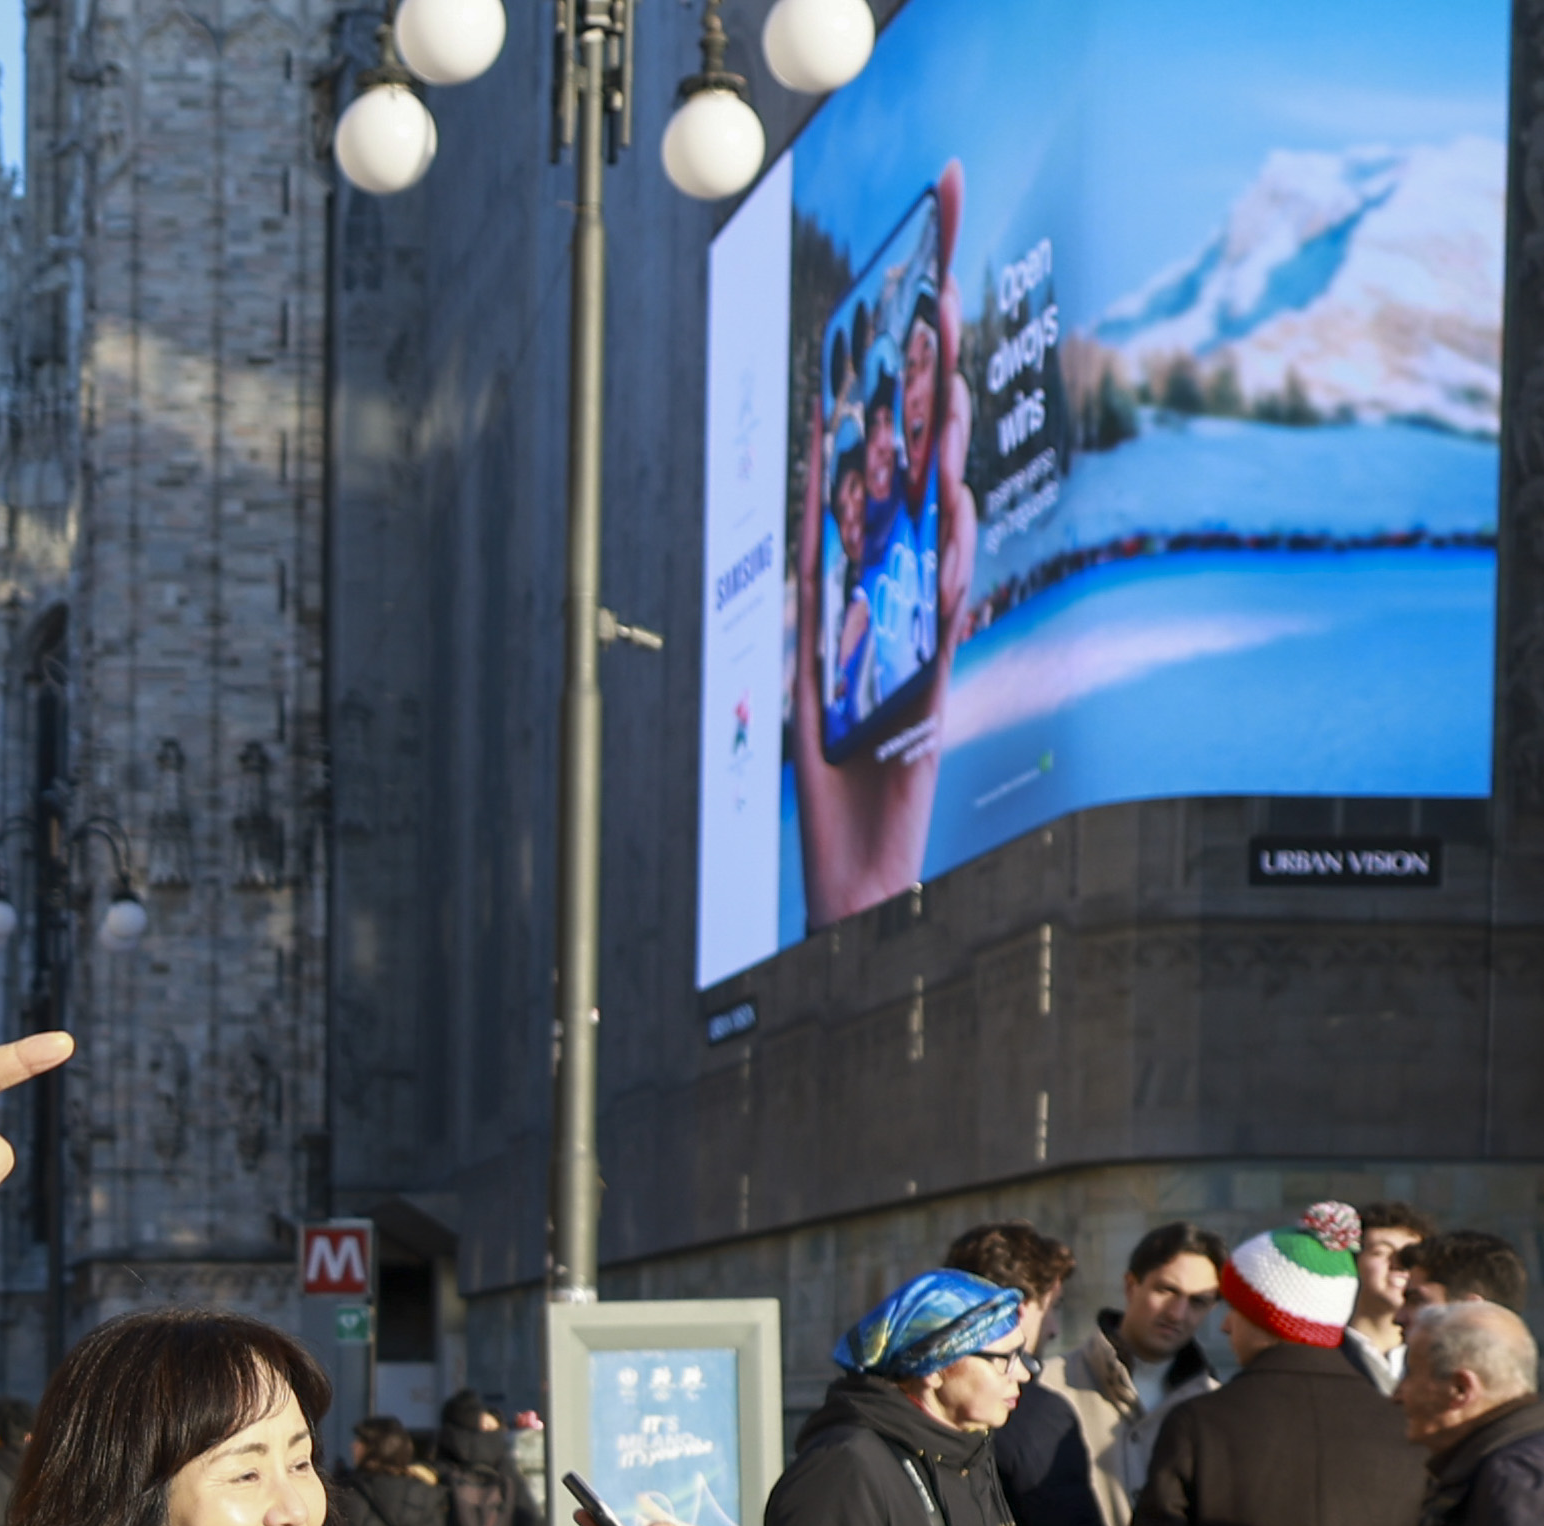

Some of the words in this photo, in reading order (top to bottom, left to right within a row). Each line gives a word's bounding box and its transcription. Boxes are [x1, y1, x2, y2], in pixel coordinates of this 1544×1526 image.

[987, 304, 1058, 393] always
[716, 532, 774, 611] SAMSUNG
[1261, 849, 1342, 875] URBAN
[1347, 849, 1429, 875] VISION
[307, 1235, 366, 1282] M
